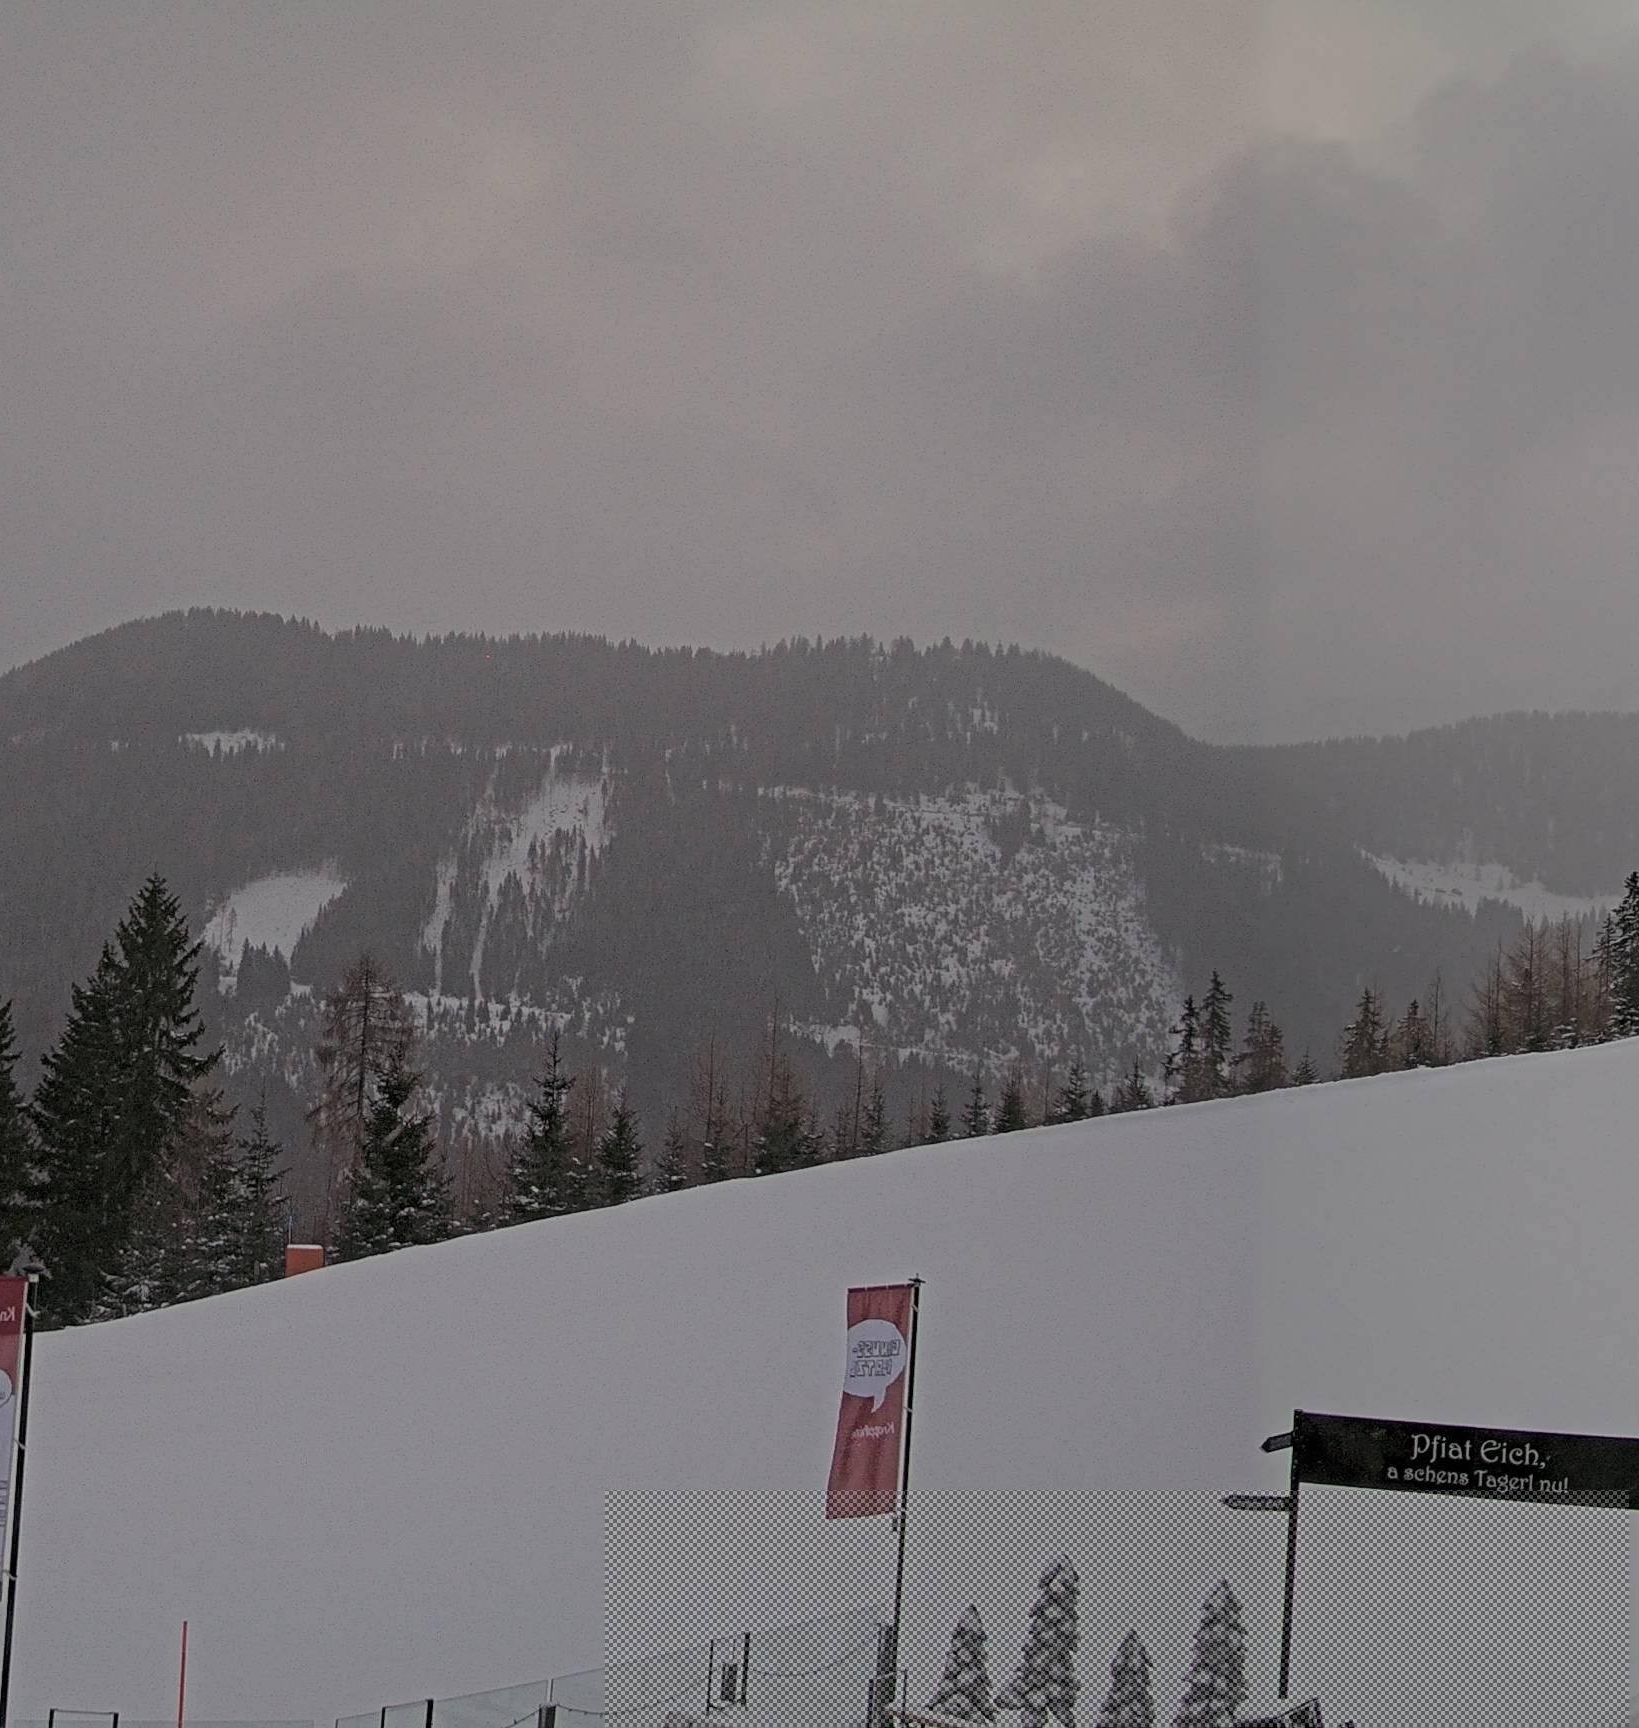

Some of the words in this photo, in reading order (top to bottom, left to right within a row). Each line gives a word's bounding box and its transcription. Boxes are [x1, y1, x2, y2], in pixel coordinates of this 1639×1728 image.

[1410, 1433, 1472, 1463] Pfiat
[1480, 1440, 1546, 1469] Eich,
[1387, 1466, 1398, 1479] a
[1403, 1465, 1469, 1485] schens
[1473, 1470, 1533, 1493] Tagerl
[1539, 1476, 1569, 1493] nu!
